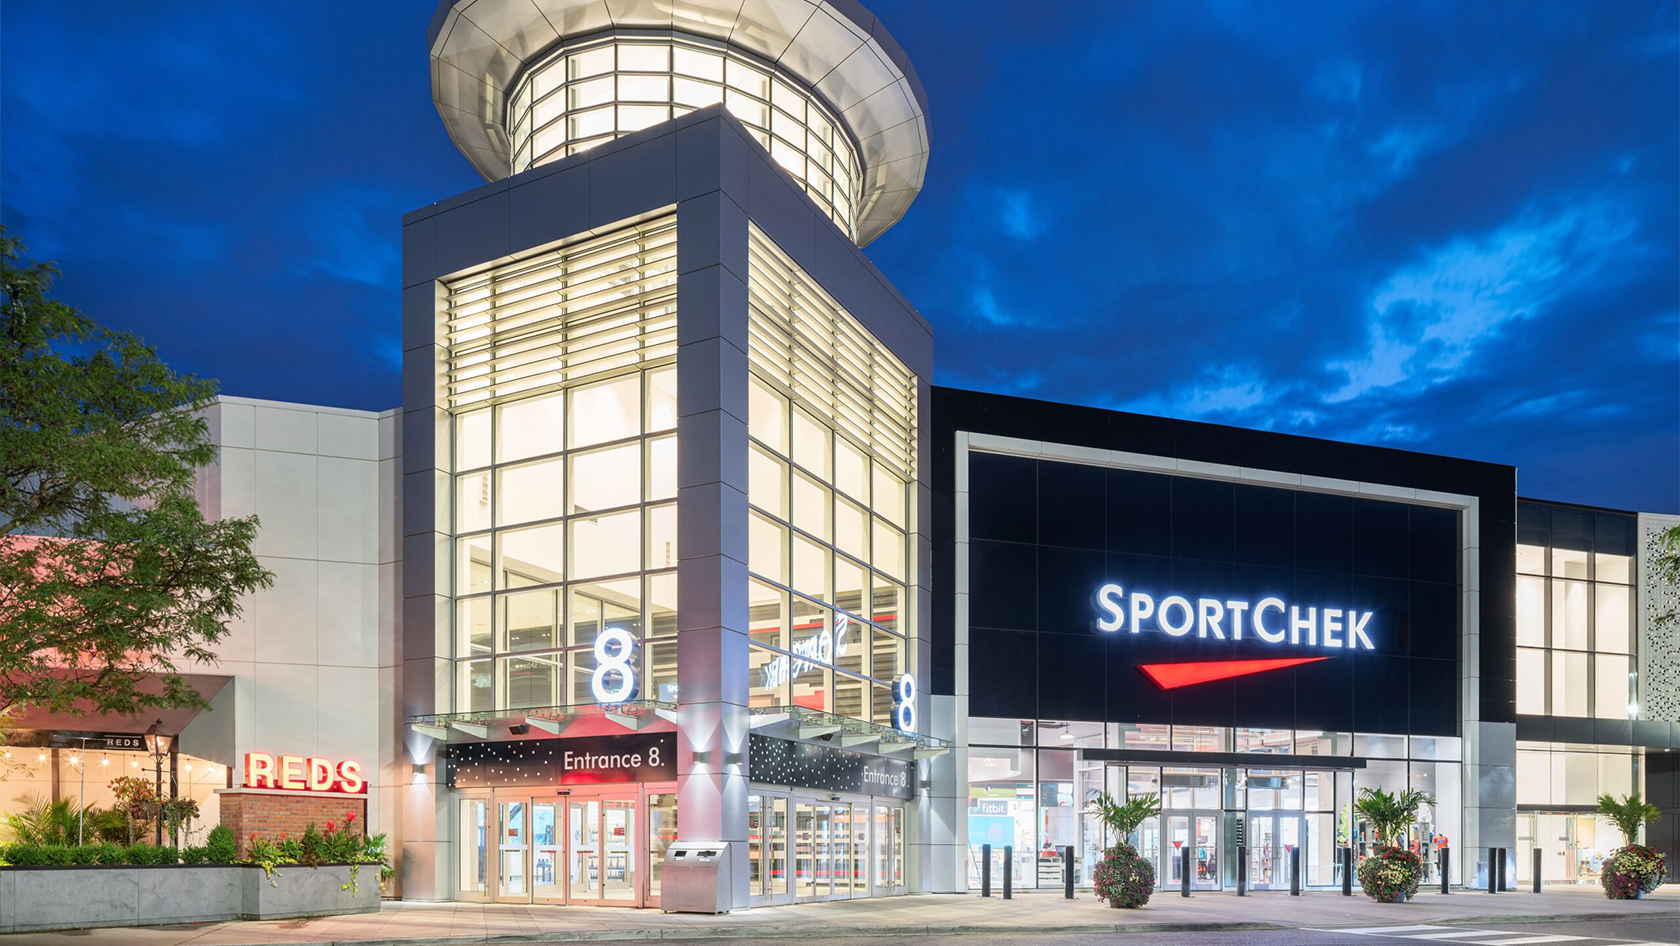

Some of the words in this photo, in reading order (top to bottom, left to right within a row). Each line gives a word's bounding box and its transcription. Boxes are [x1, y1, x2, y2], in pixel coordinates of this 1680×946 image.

[1097, 583, 1376, 650] SPORTCHEK
[591, 627, 634, 703] 8
[898, 673, 916, 733] 8
[106, 738, 139, 747] REDS
[564, 751, 642, 770] Entrance
[245, 752, 363, 794] REDS
[863, 765, 899, 787] Entrance
